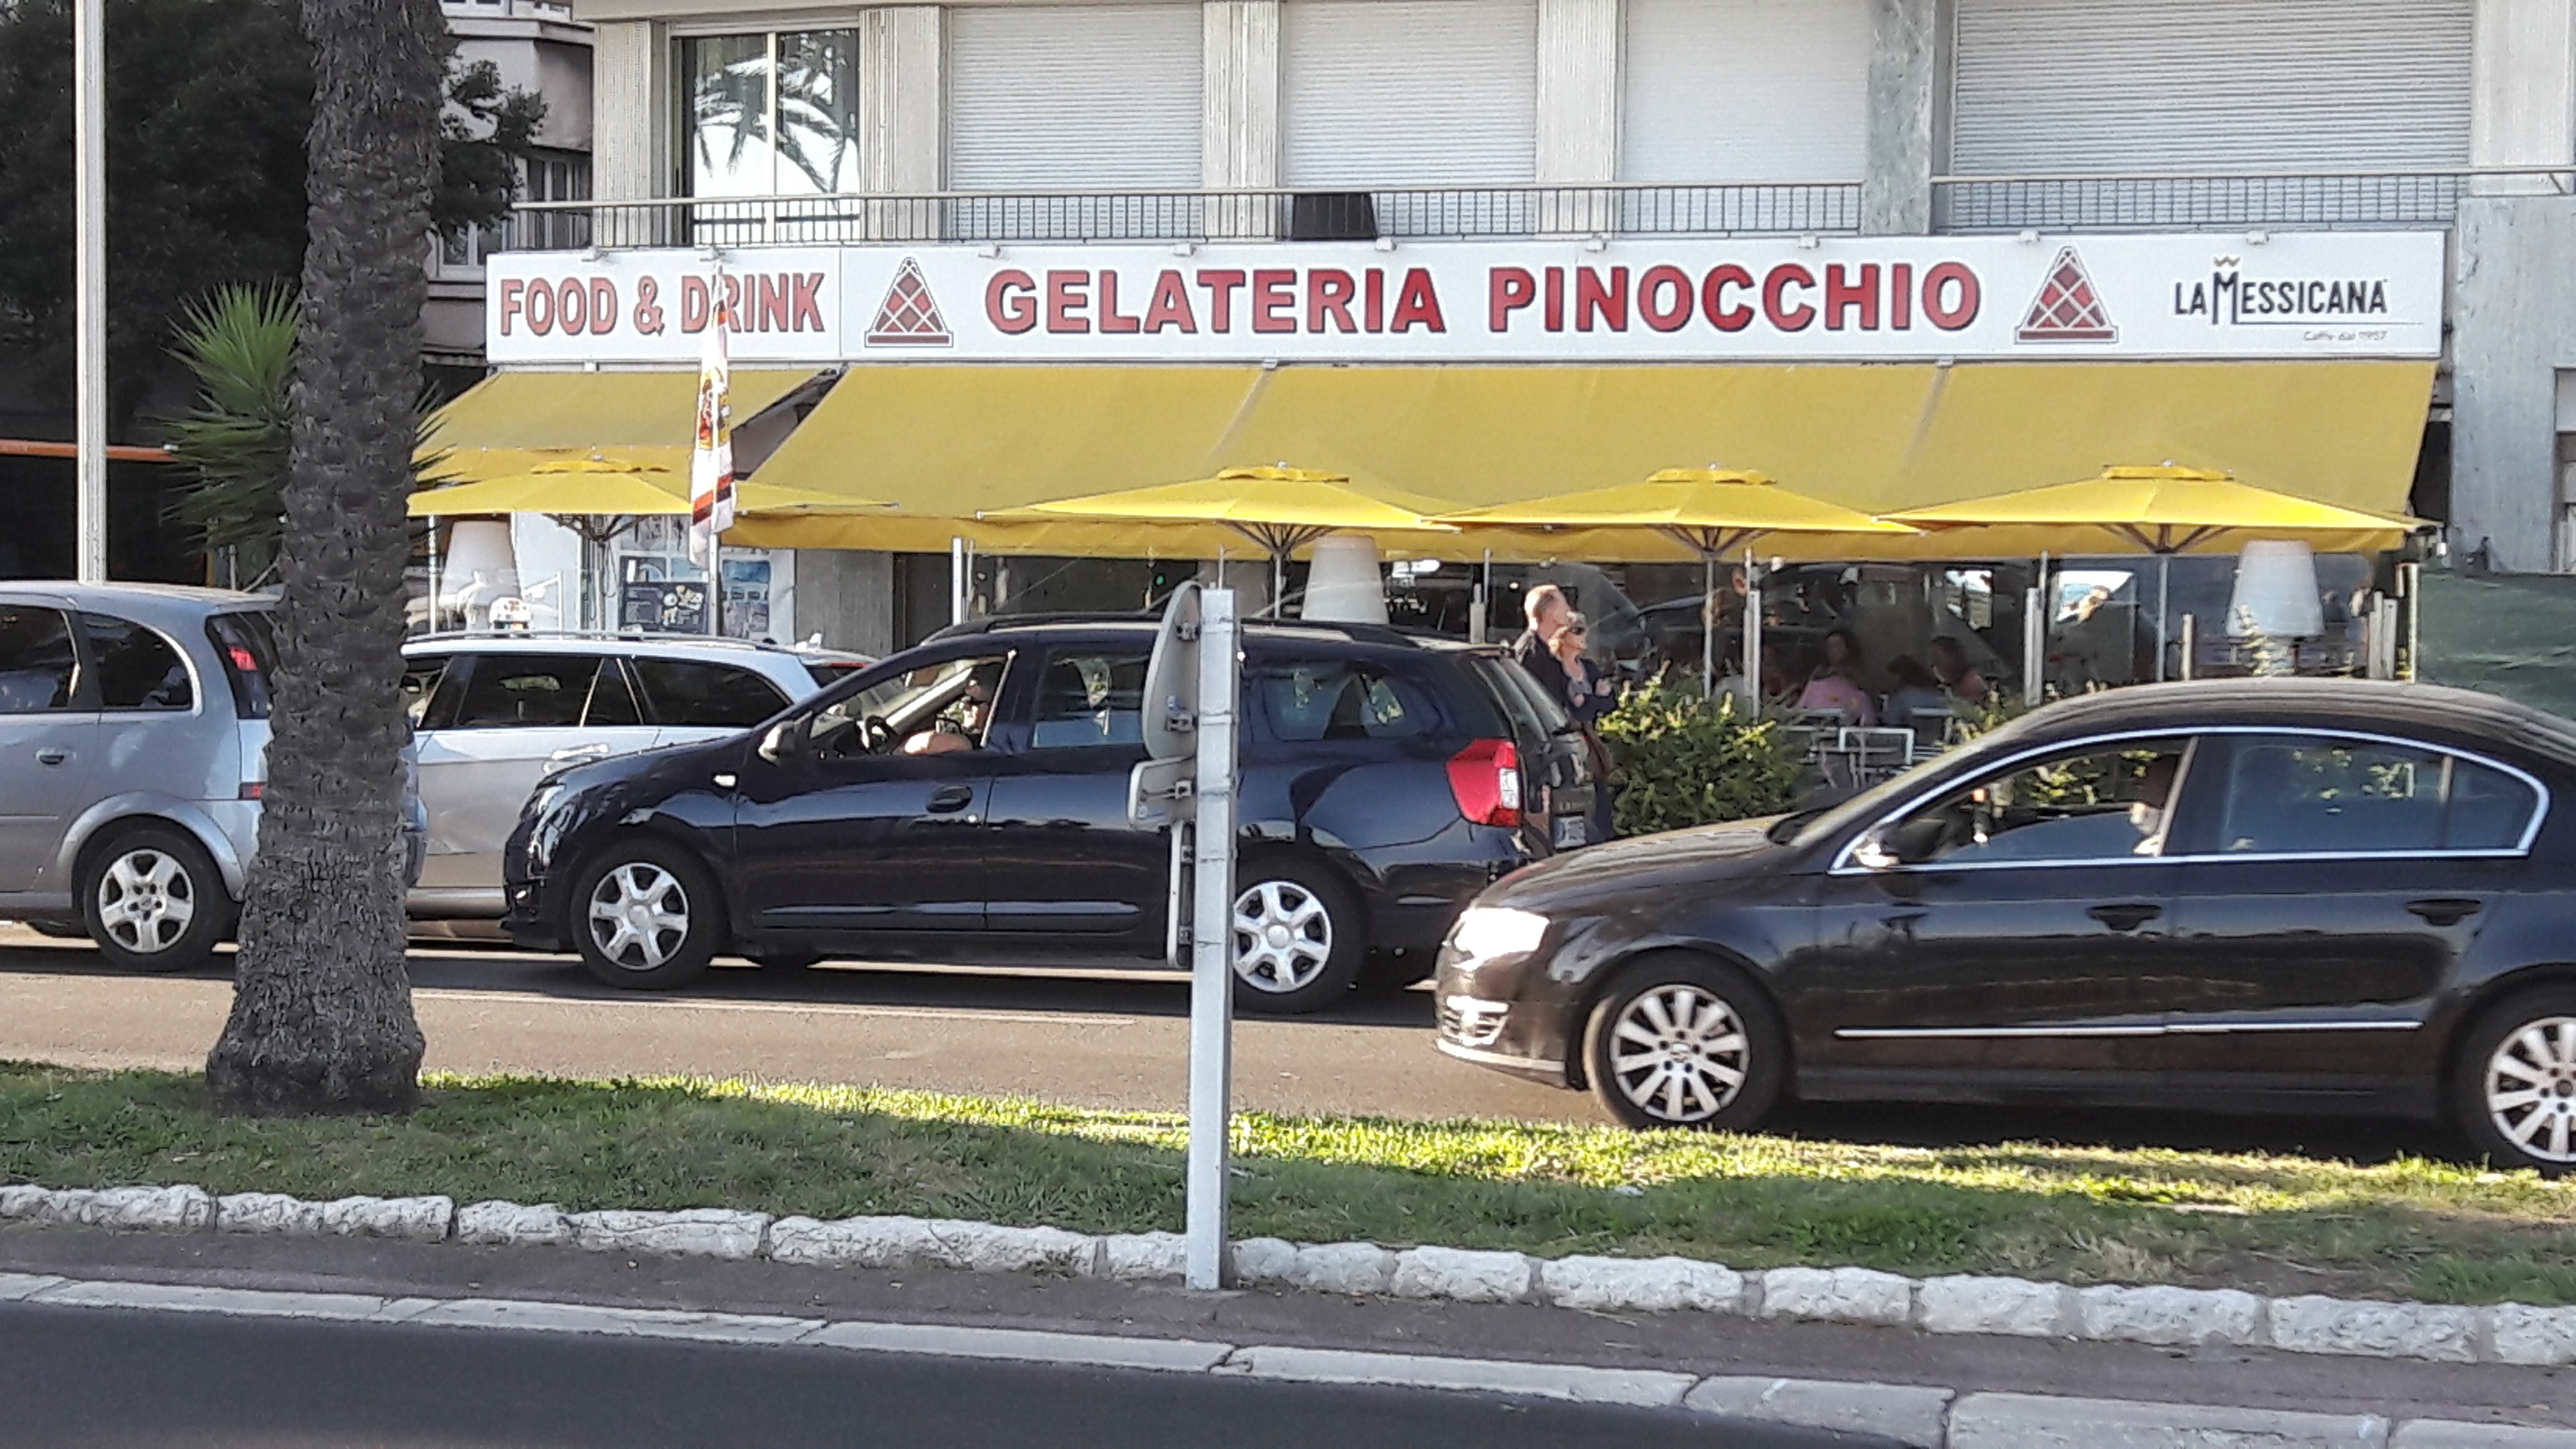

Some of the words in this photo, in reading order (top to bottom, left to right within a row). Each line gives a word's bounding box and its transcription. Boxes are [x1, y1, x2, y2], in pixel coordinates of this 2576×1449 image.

[500, 275, 618, 336] FOOD
[632, 275, 665, 336] &
[680, 272, 826, 334] DRINK
[985, 268, 1446, 335] GELATERIA
[1488, 261, 1981, 333] PINOCCHIO
